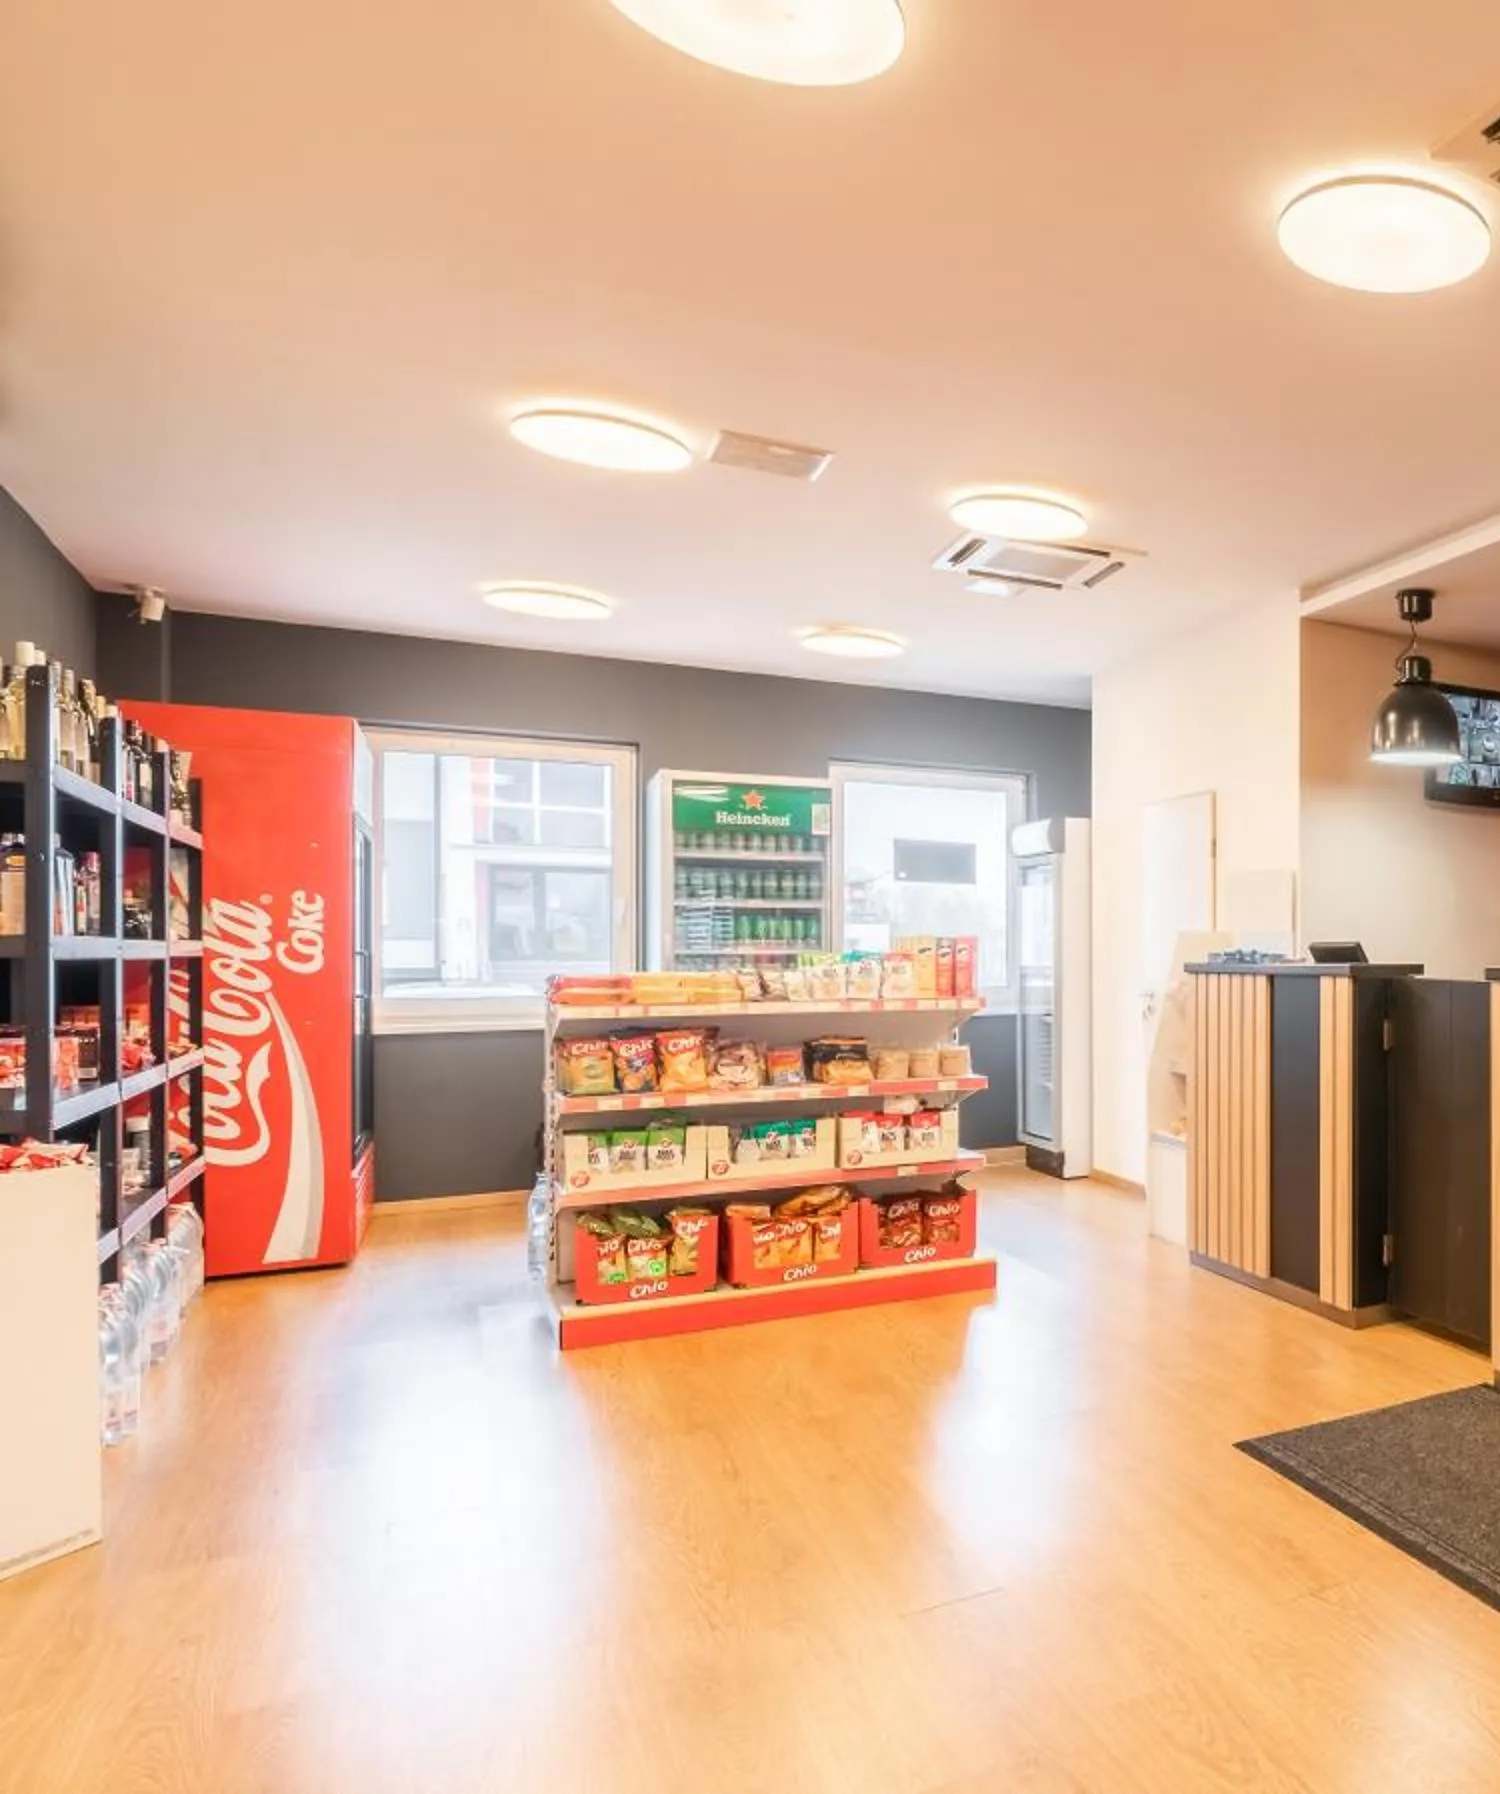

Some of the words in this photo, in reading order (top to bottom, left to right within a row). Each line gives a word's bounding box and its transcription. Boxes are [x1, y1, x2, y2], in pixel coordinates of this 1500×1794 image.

[715, 810, 792, 827] Heineken
[275, 889, 325, 974] Coke
[904, 1246, 938, 1264] Chio
[783, 1263, 818, 1281] Chio
[628, 1280, 670, 1299] Chio
